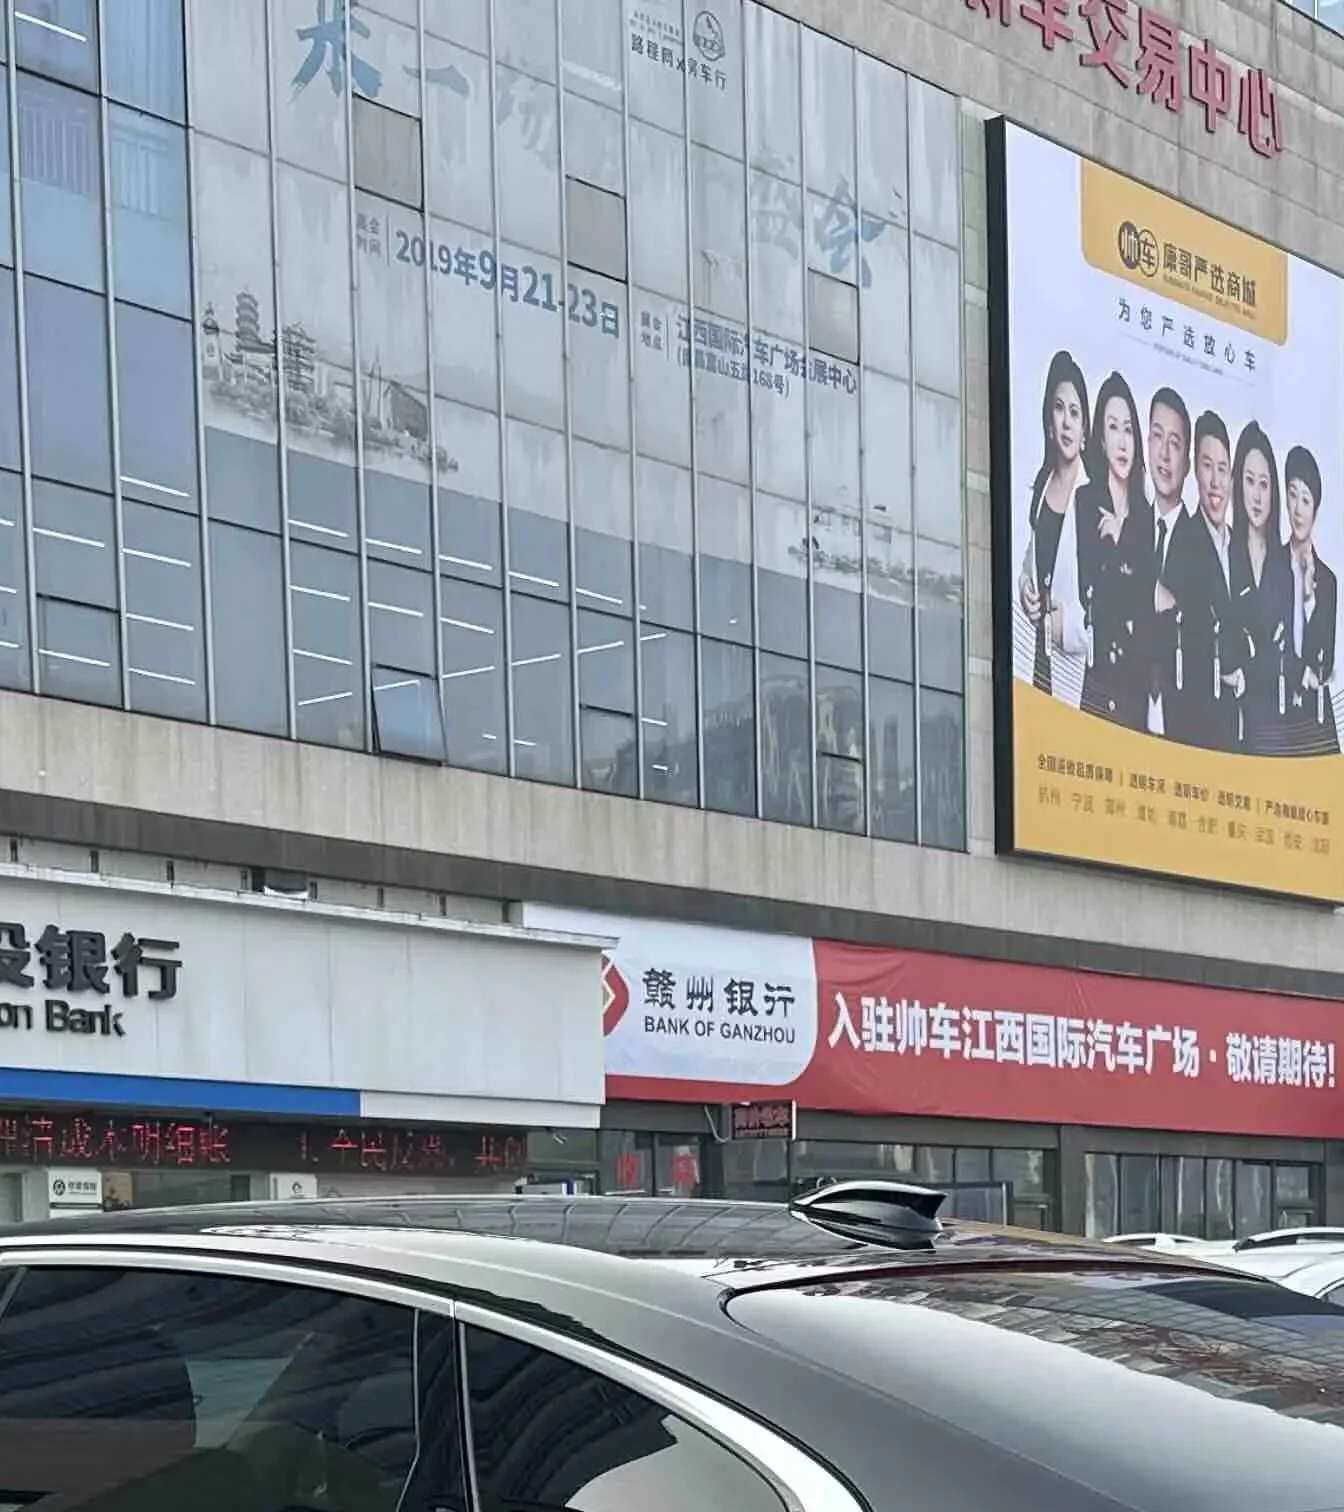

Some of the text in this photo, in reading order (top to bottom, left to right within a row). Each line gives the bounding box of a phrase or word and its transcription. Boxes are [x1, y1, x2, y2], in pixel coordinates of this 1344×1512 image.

[1163, 242, 1256, 307] 康哥严选商城
[1118, 298, 1256, 371] 为您严选放心车
[642, 968, 796, 1018] 赣州银行
[45, 1000, 127, 1037] Bank
[645, 1015, 796, 1044] BANK OF GANZHOU
